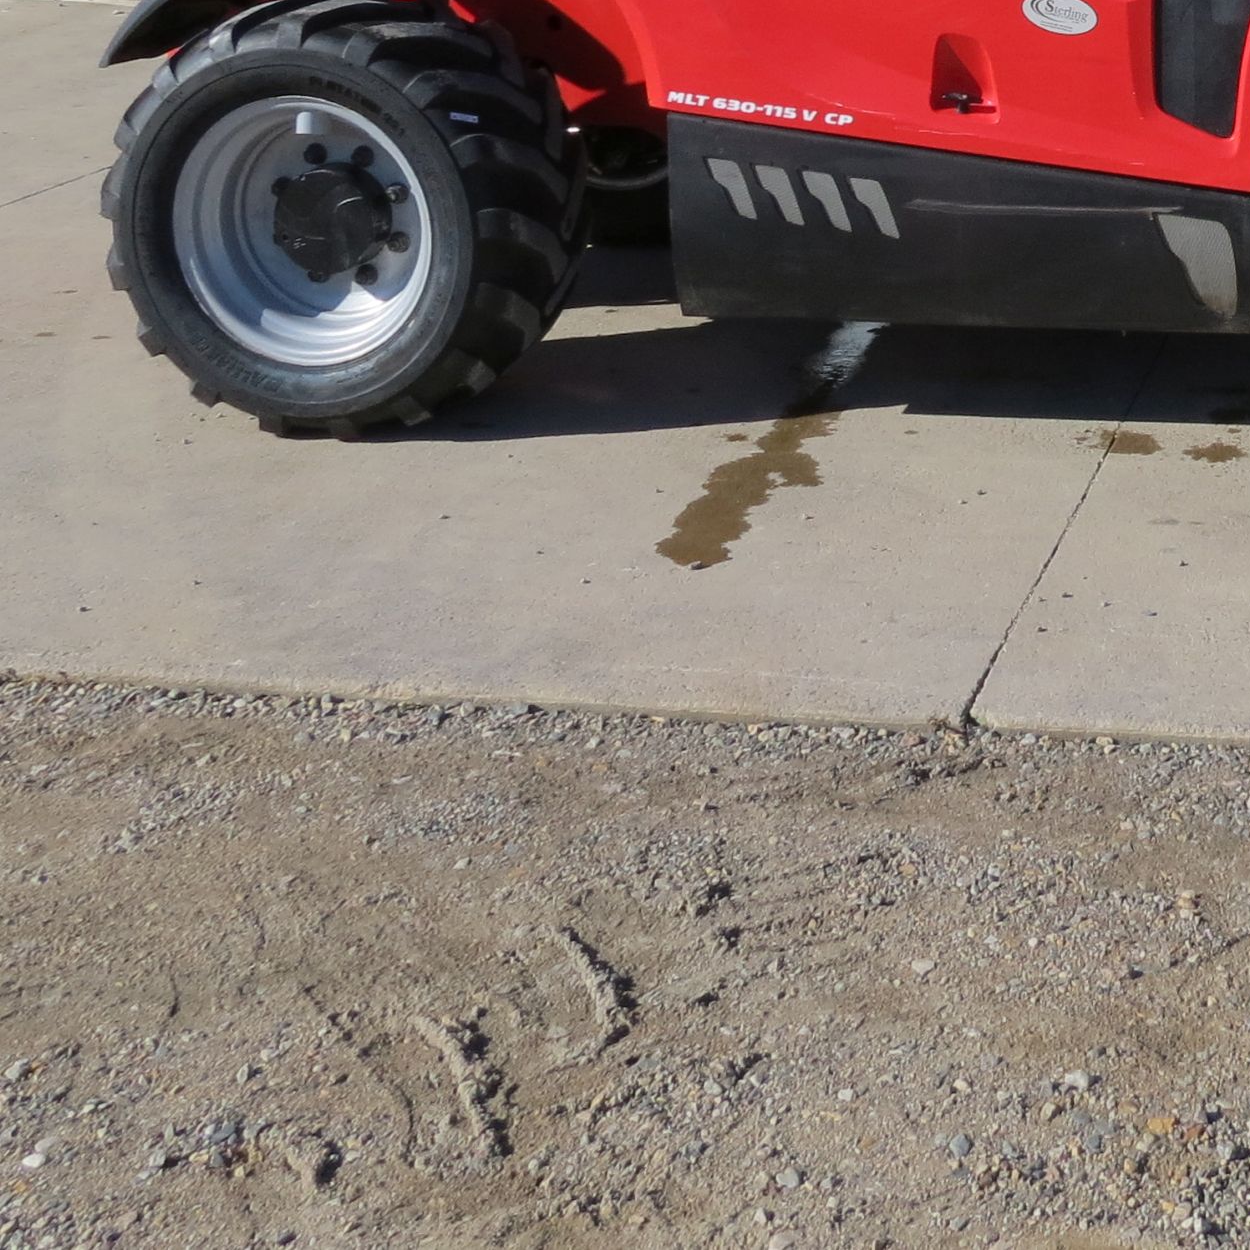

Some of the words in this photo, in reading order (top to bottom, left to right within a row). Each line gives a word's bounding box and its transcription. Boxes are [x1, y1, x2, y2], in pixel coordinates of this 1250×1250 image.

[1045, 0, 1089, 24] Sterling
[667, 90, 710, 107] MLT
[712, 97, 798, 120] 630-115
[802, 109, 818, 122] V
[824, 112, 854, 126] CP
